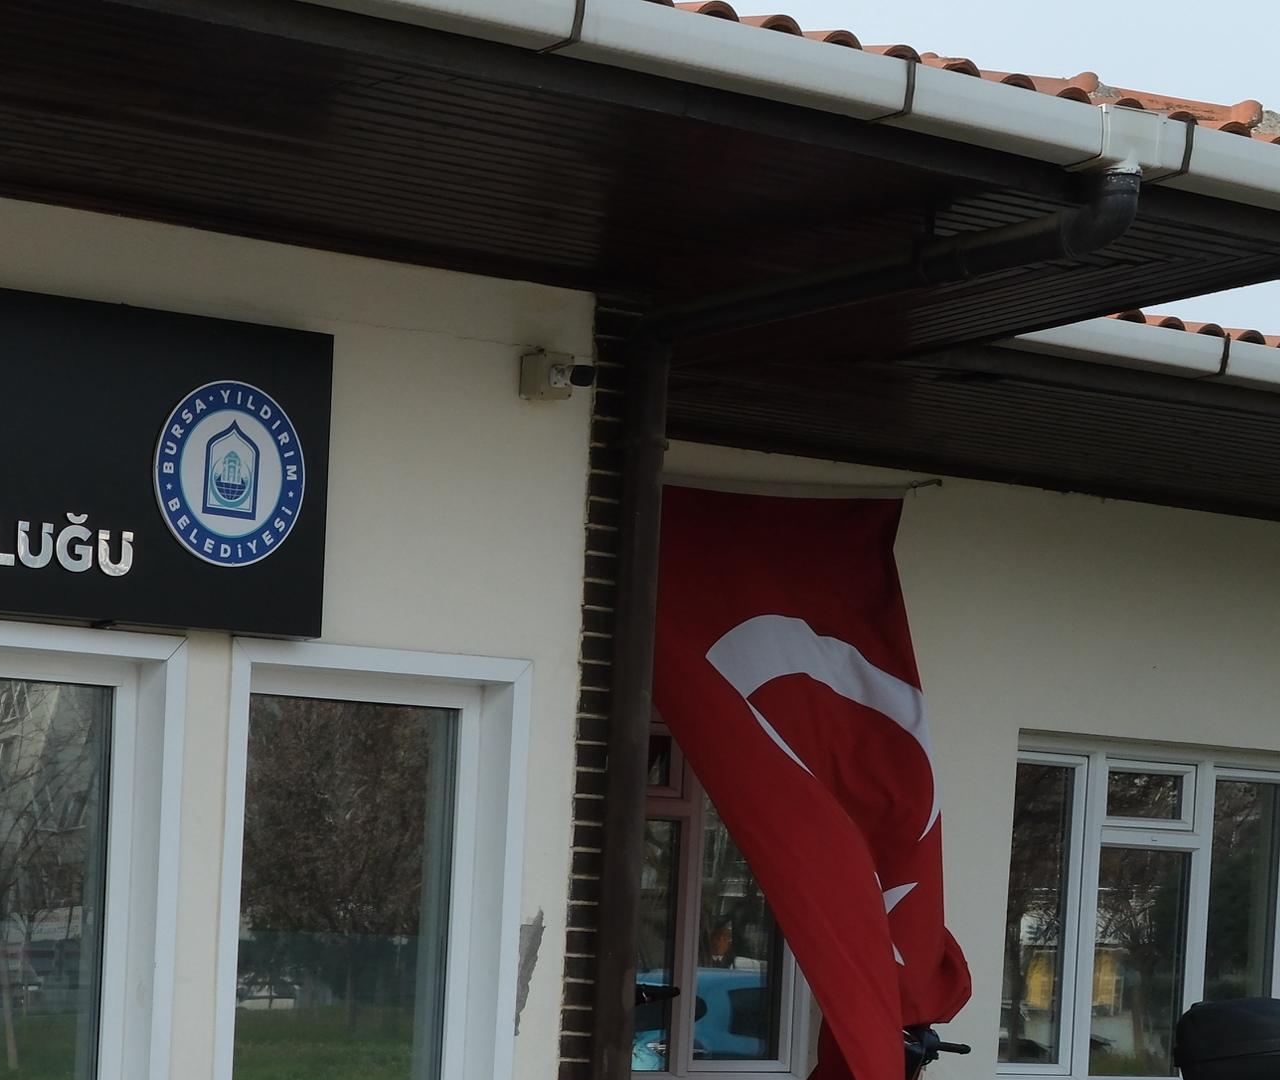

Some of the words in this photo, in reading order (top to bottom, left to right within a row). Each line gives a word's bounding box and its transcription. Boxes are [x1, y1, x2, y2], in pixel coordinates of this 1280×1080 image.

[162, 398, 207, 474] BURSA
[220, 389, 298, 481] YILDIRIM
[168, 497, 293, 558] BELEDİYESİ
